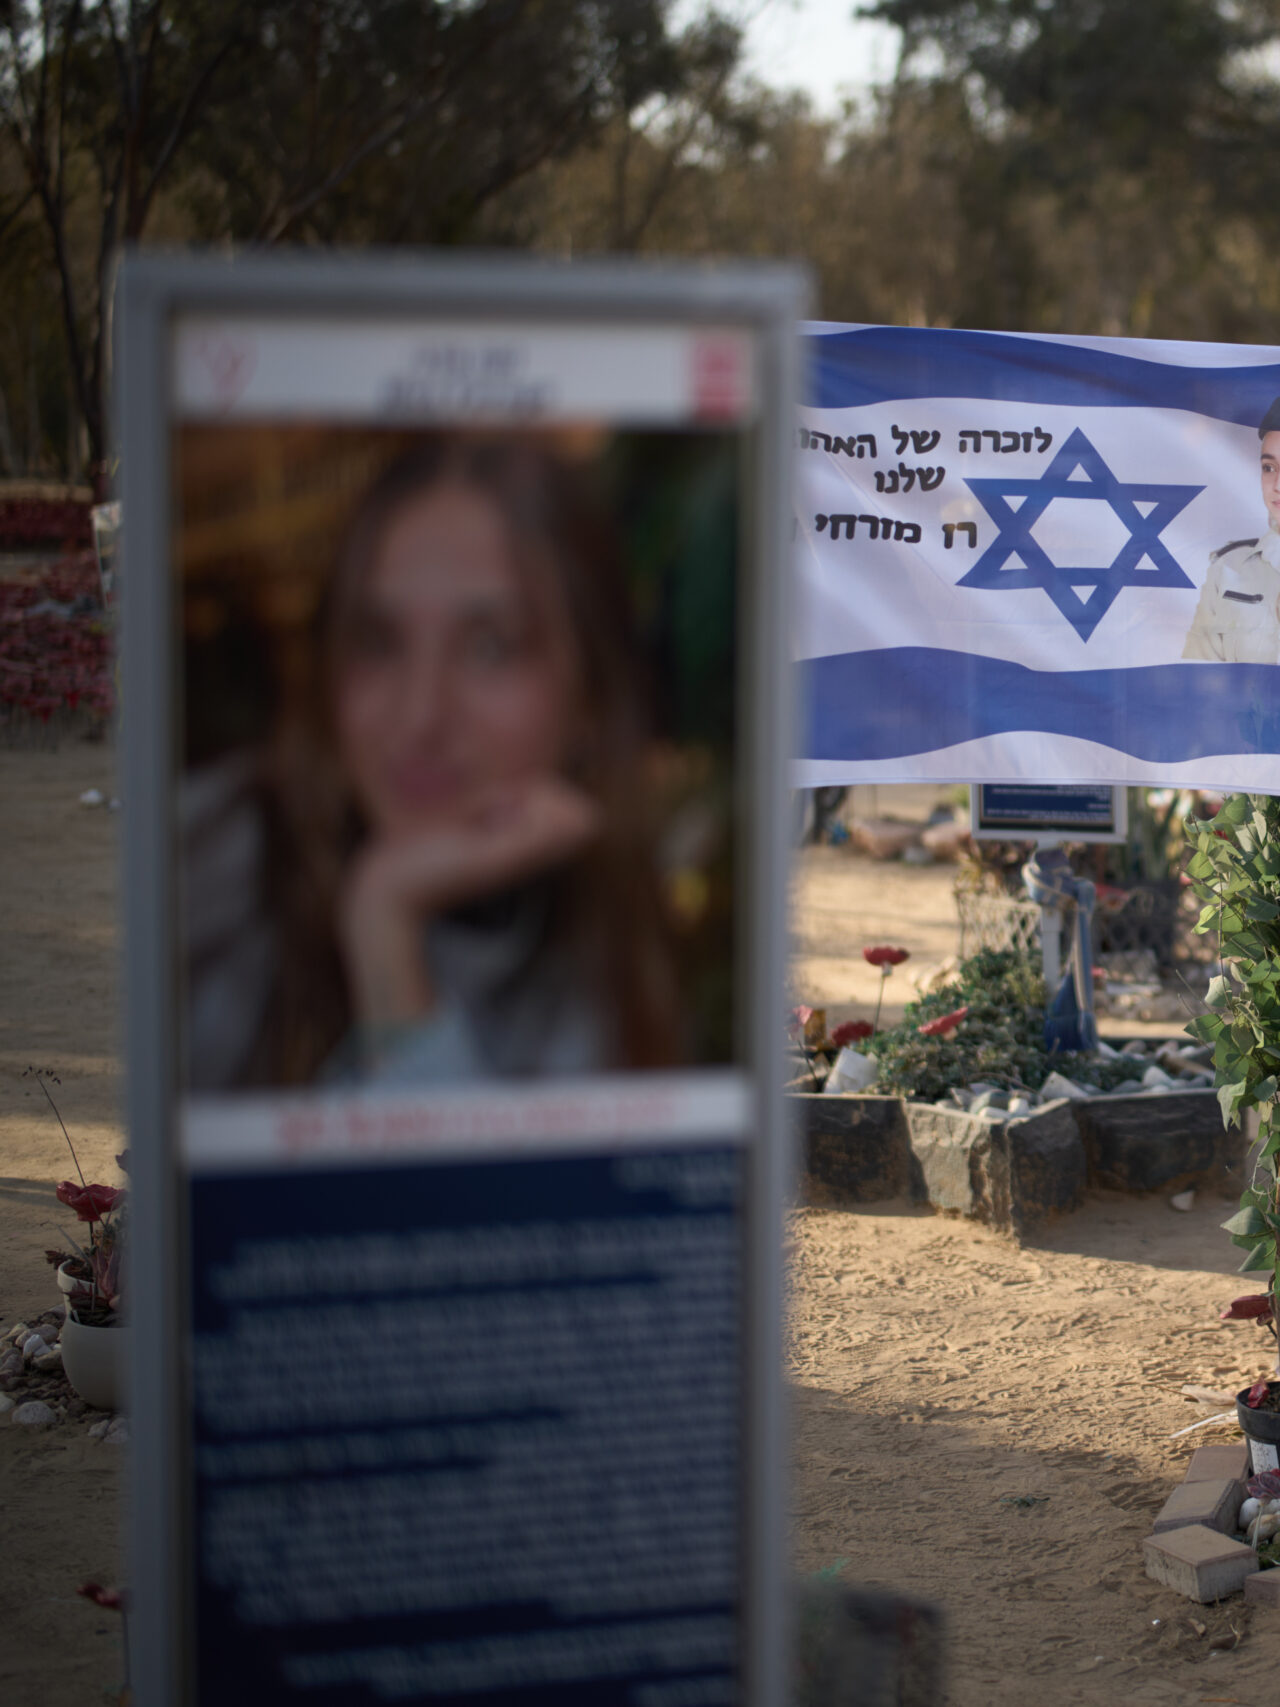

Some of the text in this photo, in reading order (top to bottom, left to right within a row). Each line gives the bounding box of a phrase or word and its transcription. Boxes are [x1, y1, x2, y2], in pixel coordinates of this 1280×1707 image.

[891, 424, 941, 455] של
[959, 427, 1053, 453] לזכרה
[874, 462, 945, 493] שלנו
[815, 513, 922, 543] מזרחי
[942, 521, 977, 549] רז
